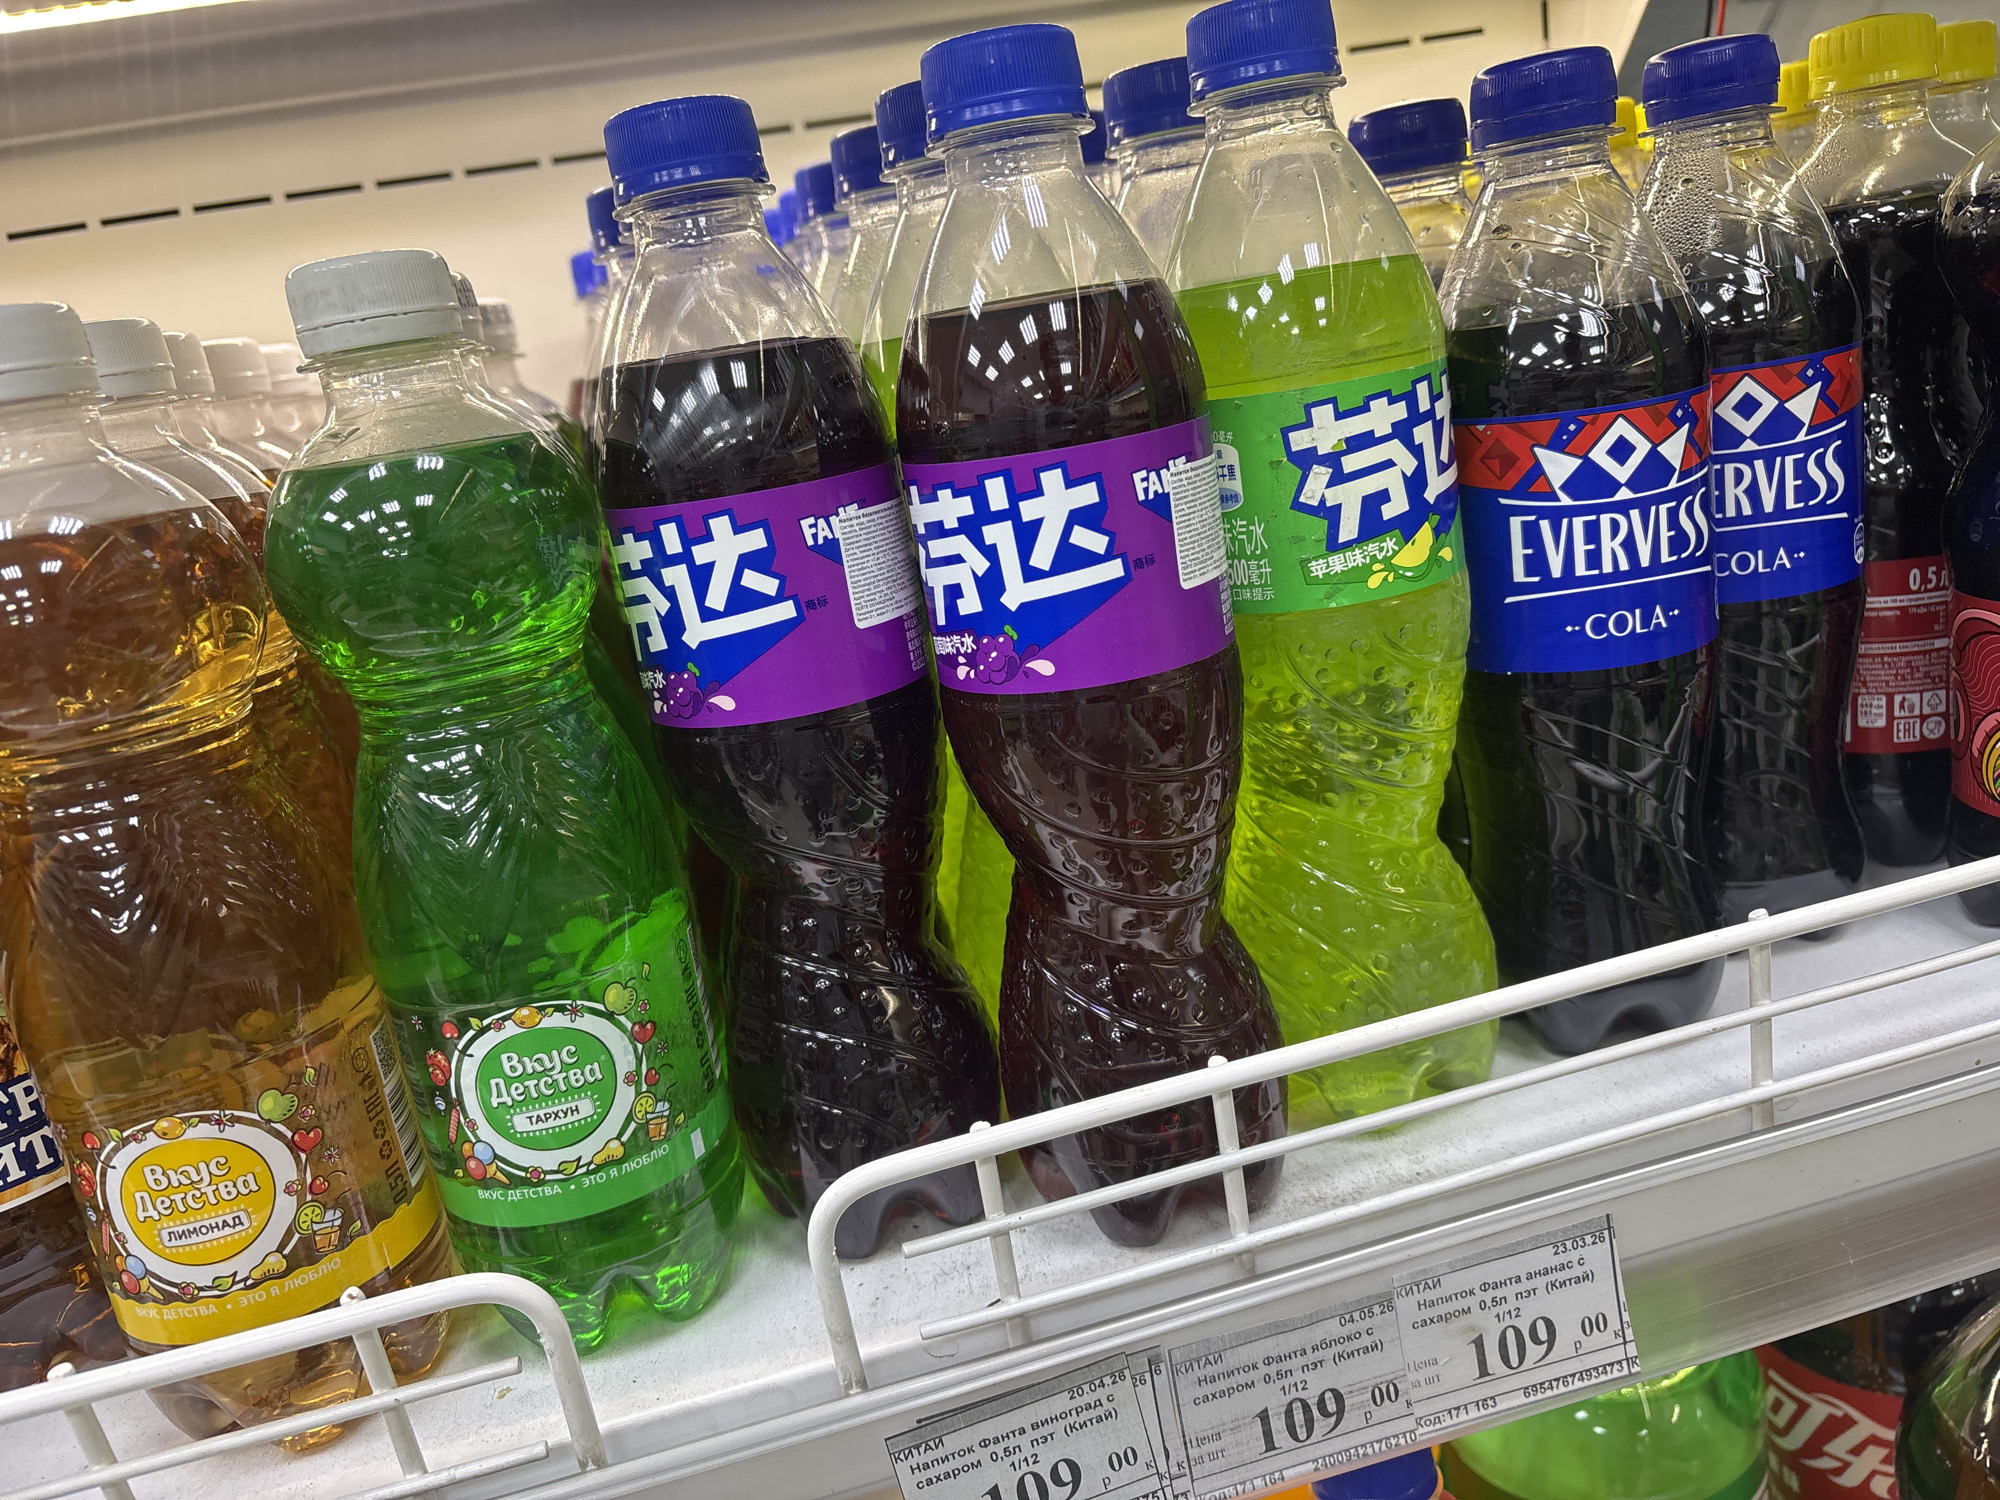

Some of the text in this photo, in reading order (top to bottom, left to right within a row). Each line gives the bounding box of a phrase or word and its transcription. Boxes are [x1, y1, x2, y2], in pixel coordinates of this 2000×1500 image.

[1509, 484, 1711, 584] EVERVESS
[1308, 536, 1400, 580] 苹果味汽水
[1909, 566, 1937, 591] 0,5
[1585, 604, 1667, 640] COLA
[500, 1044, 579, 1078] Вкус
[489, 1061, 604, 1109] Детства
[526, 1104, 580, 1127] ТАРХУН
[142, 1155, 231, 1191] Вкус
[477, 1144, 669, 1202] ВКУС ДЕТСТВА ЭТО Я ЛЮБЛЮ
[133, 1171, 261, 1223] Детства
[167, 1215, 245, 1244] ЛИМОНАД
[1552, 1232, 1606, 1257] 23.03.26
[135, 1257, 342, 1321] ВКУС ДЕТСТВА ЭТО Я ЛЮБЛЮ
[1411, 1270, 1596, 1331] сахаром 0,5л пэт (Китай)
[1416, 1256, 1586, 1312] Напиток Фанта ананас с
[1339, 1300, 1395, 1327] 04.05.26
[1494, 1307, 1522, 1324] 1/12
[1197, 1327, 1374, 1388] Напиток Фанта яблоко с
[1466, 1315, 1557, 1381] 109
[1580, 1312, 1608, 1337] 00
[1068, 1371, 1127, 1400] 20.04.26
[1192, 1338, 1385, 1407] сахаром 0,5л пэт (Китай)
[1280, 1379, 1309, 1397] 1/12
[1522, 1361, 1625, 1399] 6954767493473
[1252, 1387, 1347, 1456] 109
[1371, 1381, 1400, 1407] 00
[1473, 1396, 1498, 1415] 163
[909, 1393, 1115, 1475] Напиток Фанта виноград с
[916, 1407, 1119, 1491] сахаром 0,5л пэт (Китай)
[1009, 1453, 1041, 1472] 1/12
[1108, 1446, 1138, 1473] 00
